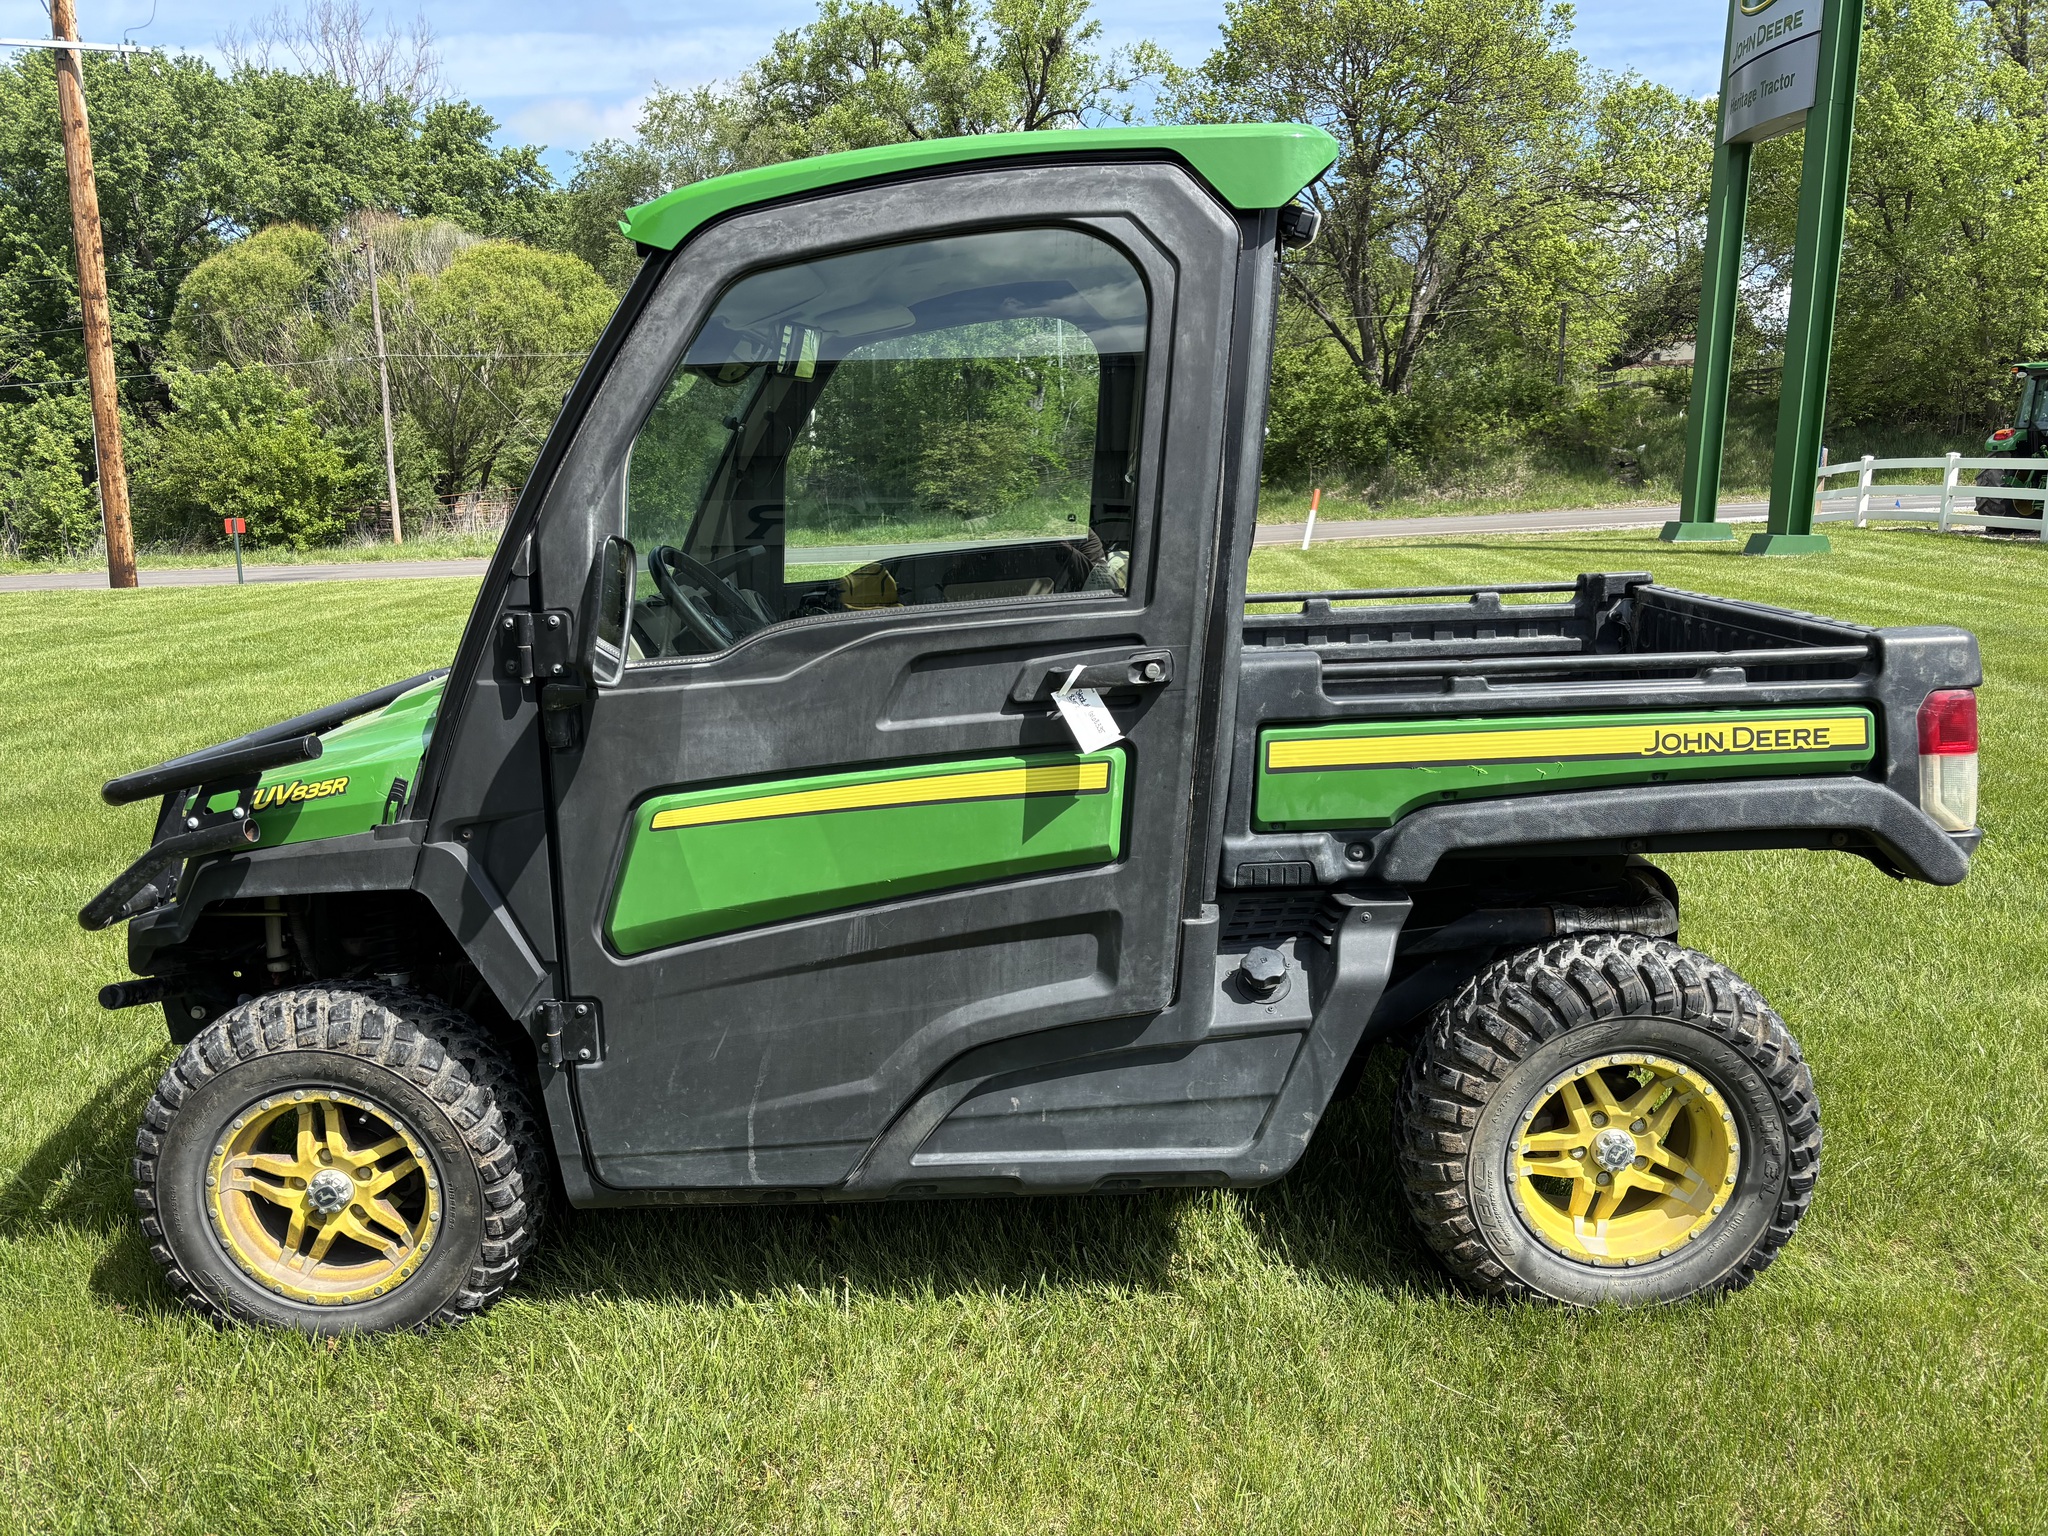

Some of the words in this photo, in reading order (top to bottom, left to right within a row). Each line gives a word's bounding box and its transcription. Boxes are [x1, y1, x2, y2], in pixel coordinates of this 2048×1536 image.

[1733, 33, 1756, 63] JOHN
[1757, 9, 1803, 46] DEERE
[1730, 89, 1757, 115] Heritage
[1760, 72, 1795, 98] Tractor
[1644, 730, 1724, 753] JOHN
[1732, 726, 1830, 749] DEERE
[253, 775, 350, 810] UV835R
[1714, 1049, 1781, 1201] MONGREL
[1706, 1211, 1747, 1254] TUBELESS
